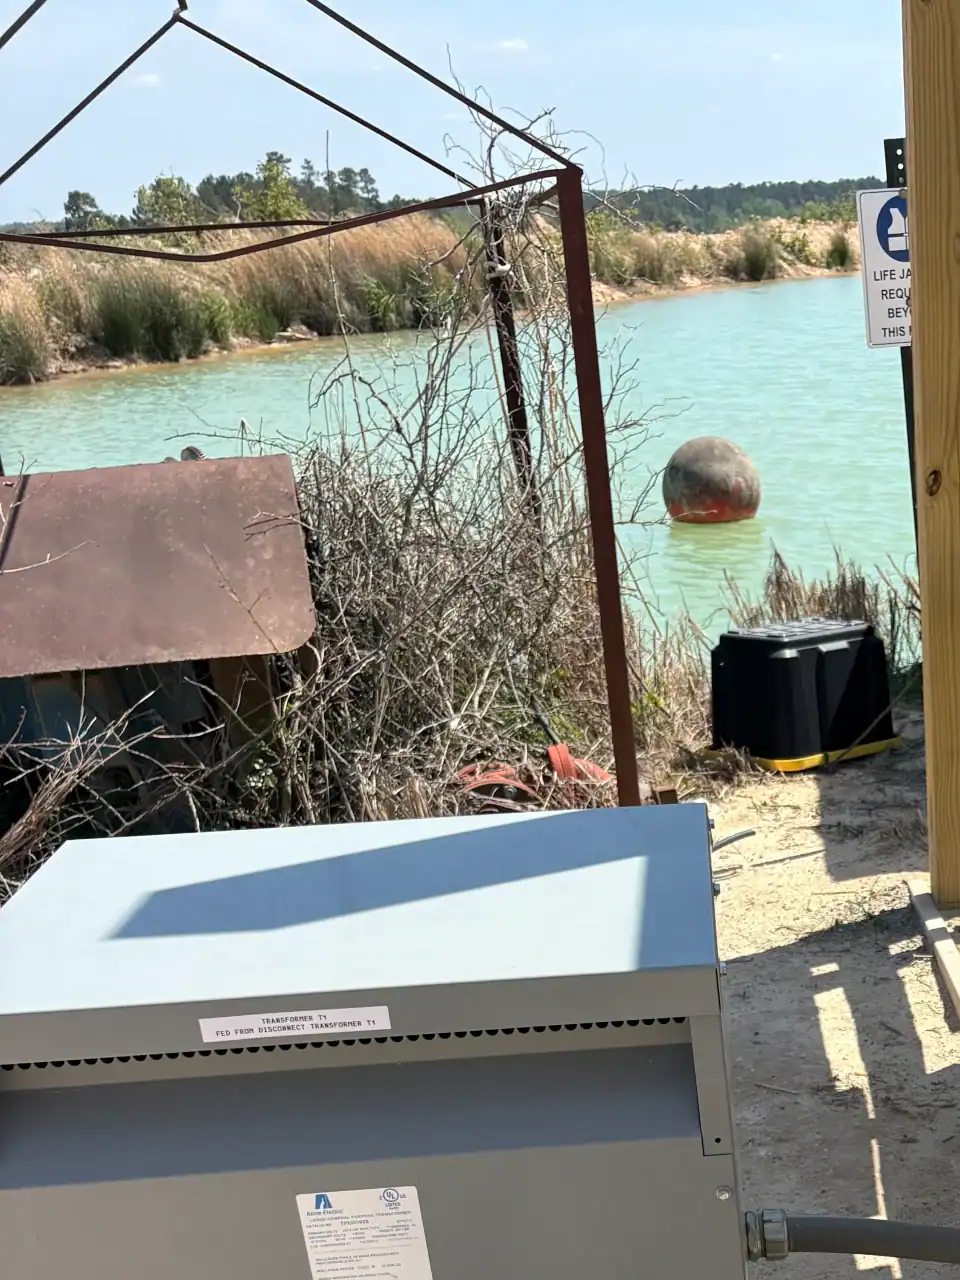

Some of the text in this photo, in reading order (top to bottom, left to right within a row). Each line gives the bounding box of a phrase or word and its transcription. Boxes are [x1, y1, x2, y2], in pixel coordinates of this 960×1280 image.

[873, 268, 912, 282] LIFE JA
[881, 288, 911, 300] REQU
[887, 307, 911, 319] BEY
[881, 326, 906, 338] THIS
[261, 1015, 314, 1025] TRANSFORMER
[234, 1027, 255, 1035] FROM
[258, 1024, 306, 1034] DISCONNECT
[310, 1020, 363, 1030] TRANSFORMER
